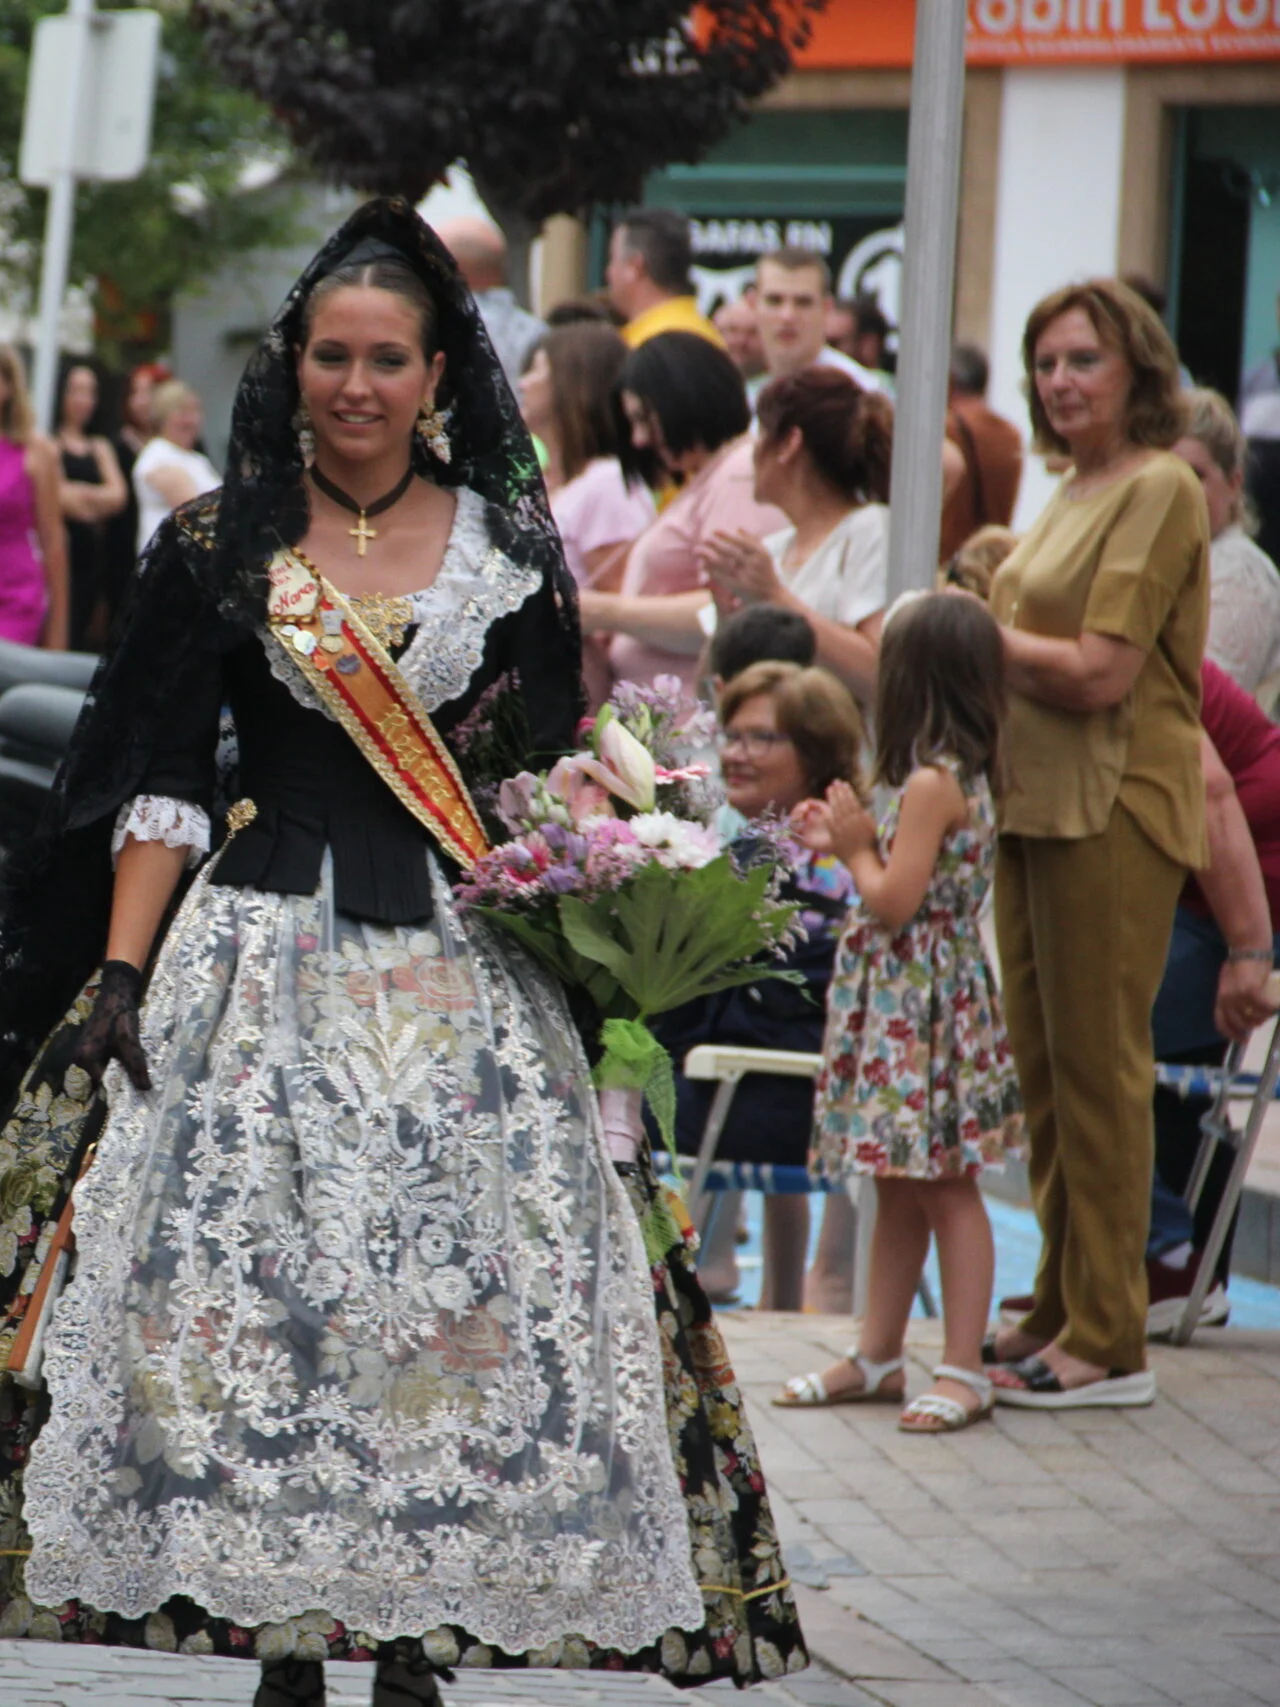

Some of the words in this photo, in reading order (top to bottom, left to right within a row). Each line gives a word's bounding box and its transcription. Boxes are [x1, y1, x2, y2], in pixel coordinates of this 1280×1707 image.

[966, 0, 1125, 35] obin
[1141, 0, 1280, 32] Loo
[375, 703, 452, 802] Regina
